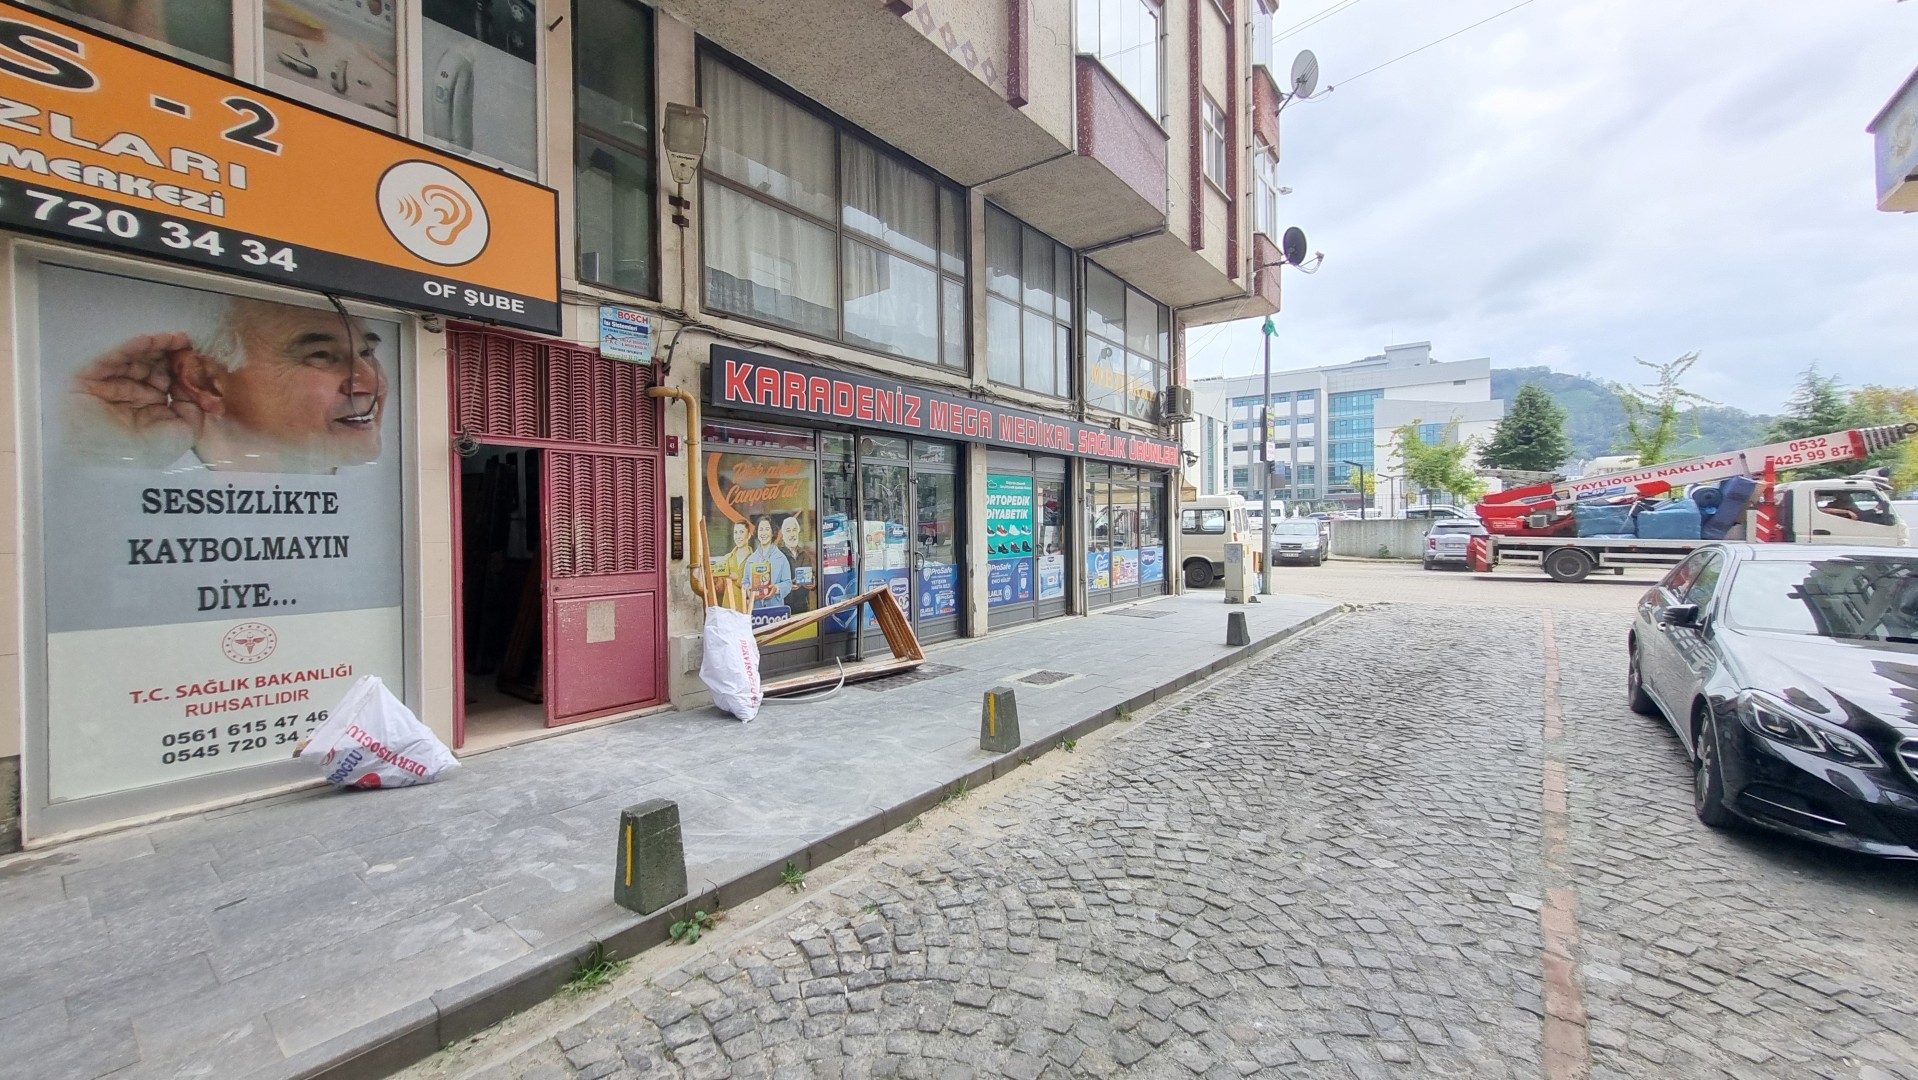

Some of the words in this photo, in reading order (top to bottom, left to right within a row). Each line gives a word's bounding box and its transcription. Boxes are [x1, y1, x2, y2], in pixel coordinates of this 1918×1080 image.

[221, 96, 283, 156] 2
[26, 189, 140, 239] 720
[160, 220, 225, 256] 34
[241, 239, 298, 272] 34
[423, 281, 457, 298] OF
[463, 289, 525, 314] ŞUBE
[617, 311, 649, 325] BOSCH
[725, 360, 921, 428] KARADENİZ
[929, 400, 992, 439] MEGA
[998, 414, 1074, 451] MEDİKAL
[1078, 428, 1126, 459] SAĞLIK
[1774, 453, 1803, 465] 425
[1807, 449, 1826, 460] 99
[1789, 438, 1828, 452] 0532
[141, 483, 339, 515] SESSİZLİKTE
[128, 535, 349, 565] KAYBOLMAYIN
[197, 579, 297, 611] DİYE...
[129, 689, 170, 704] T.C.
[175, 678, 249, 699] SAĞLIK
[255, 664, 353, 689] BAKANLIĞI
[185, 688, 310, 718] RUHSATLIDIR
[162, 727, 218, 747] 0561
[228, 720, 267, 737] 615
[274, 714, 298, 729] 47
[305, 710, 329, 723] 46
[162, 744, 220, 765] 0545
[228, 736, 267, 753] 720
[274, 730, 299, 745] 34
